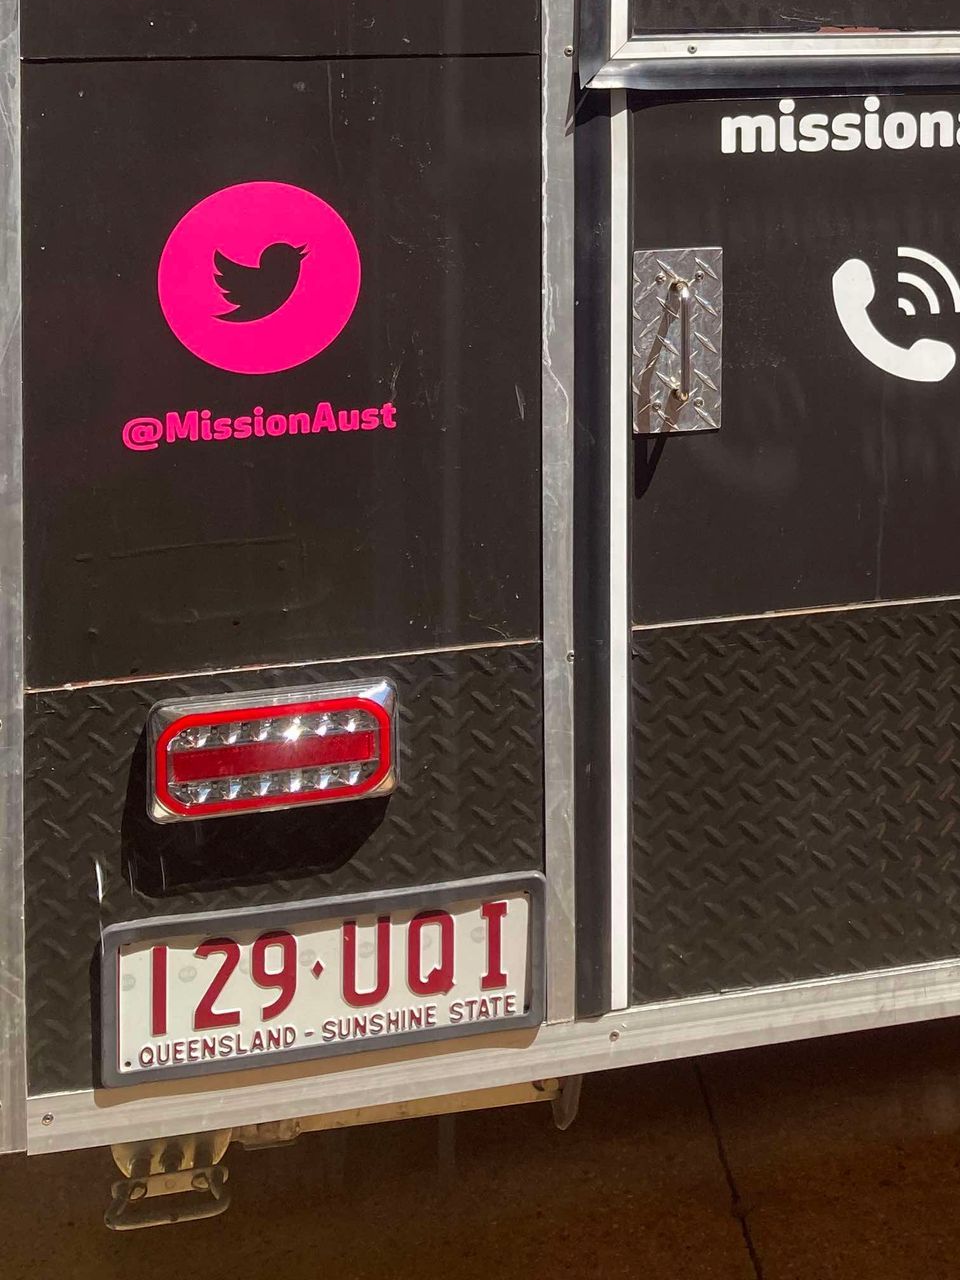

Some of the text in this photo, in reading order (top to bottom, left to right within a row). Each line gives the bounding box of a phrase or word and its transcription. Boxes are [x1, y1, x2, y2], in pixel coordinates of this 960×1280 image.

[122, 402, 397, 451] @MissionAust
[138, 1026, 298, 1068] QUEENSLAND
[322, 1005, 438, 1040] SUNSHINE
[448, 992, 517, 1023] STATE
